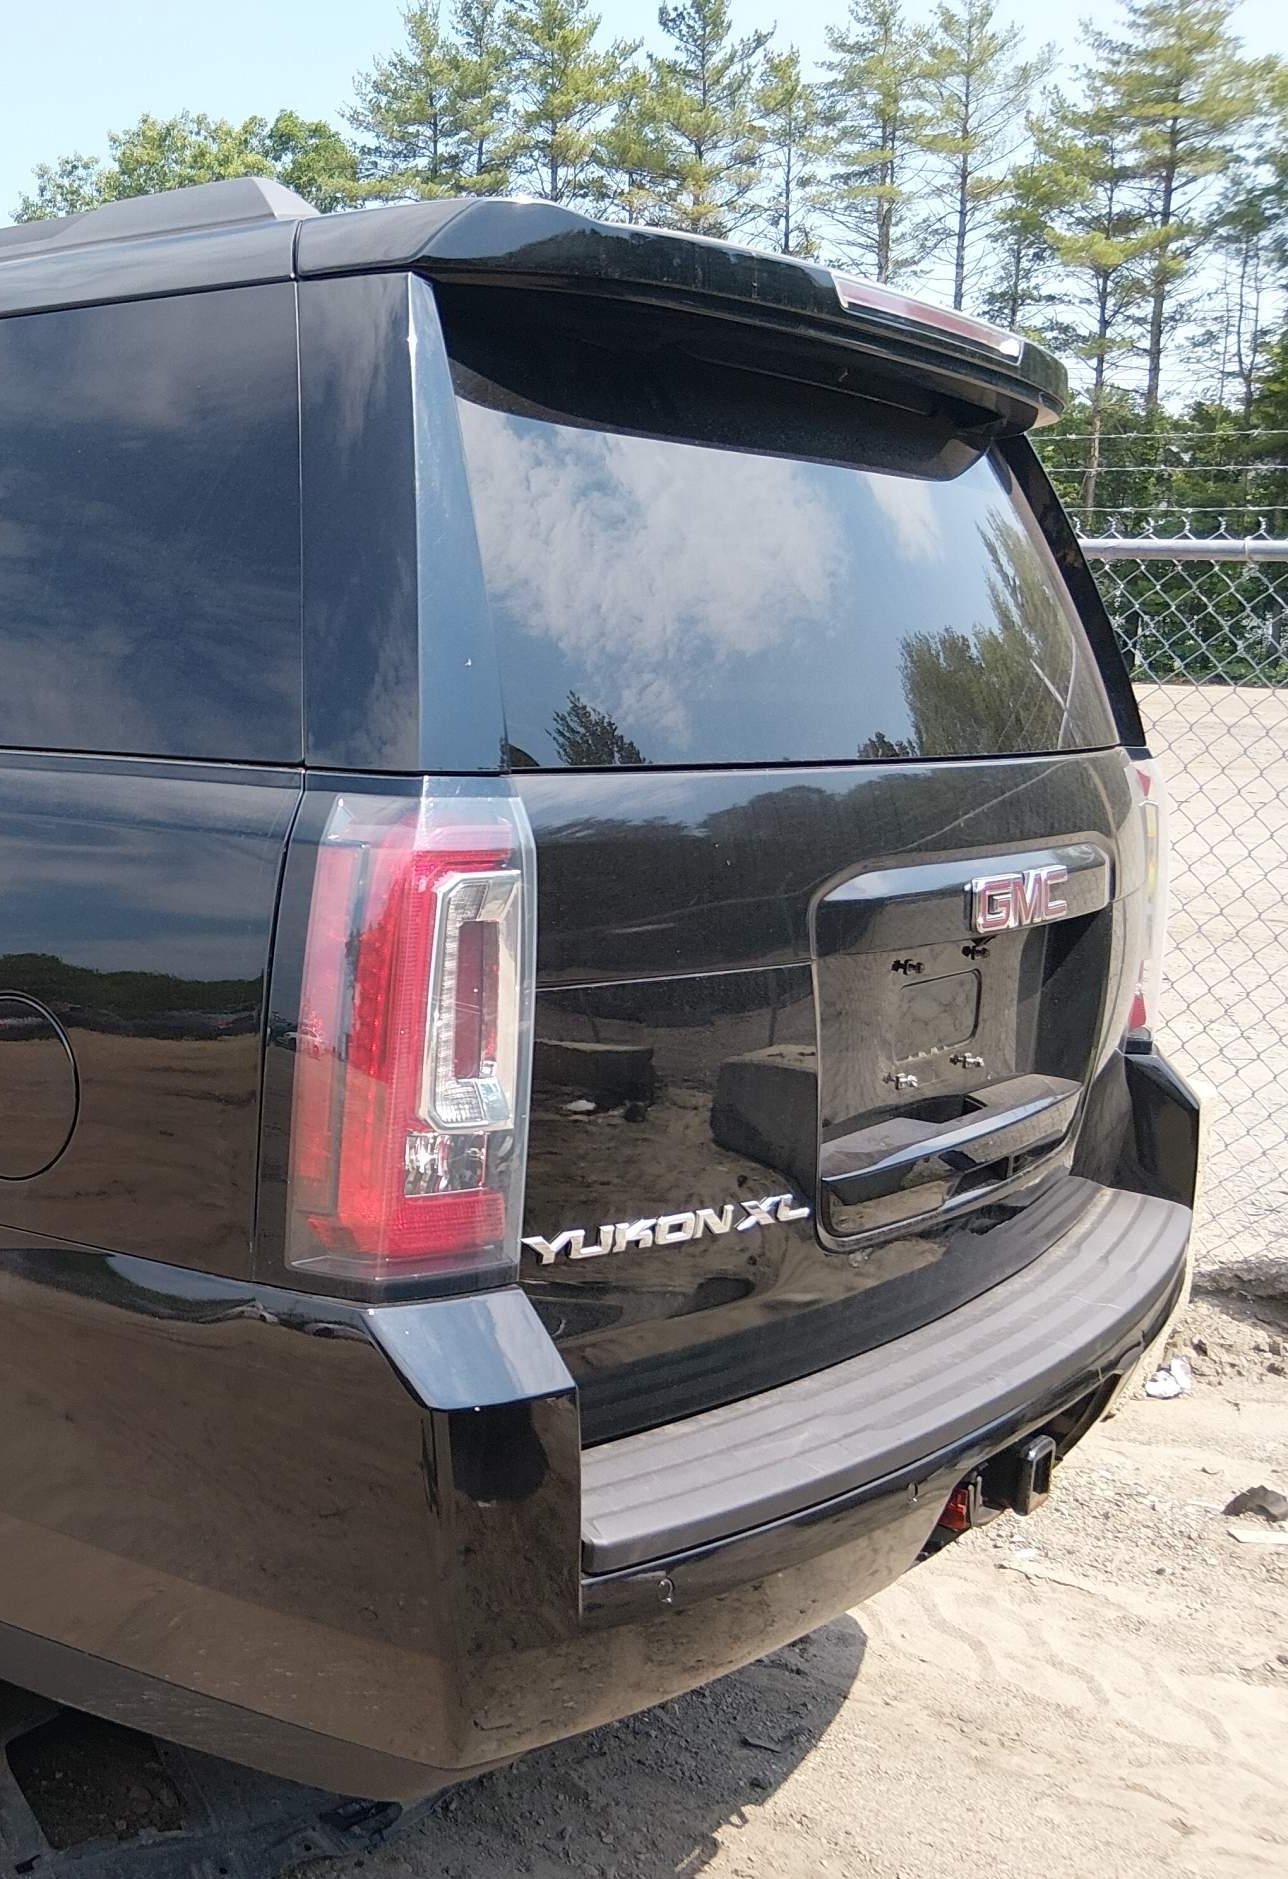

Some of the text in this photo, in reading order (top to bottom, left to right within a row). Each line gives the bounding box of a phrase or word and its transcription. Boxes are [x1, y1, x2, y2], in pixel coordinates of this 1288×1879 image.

[971, 865, 1068, 934] GMC
[520, 1193, 810, 1266] YUKON XL
